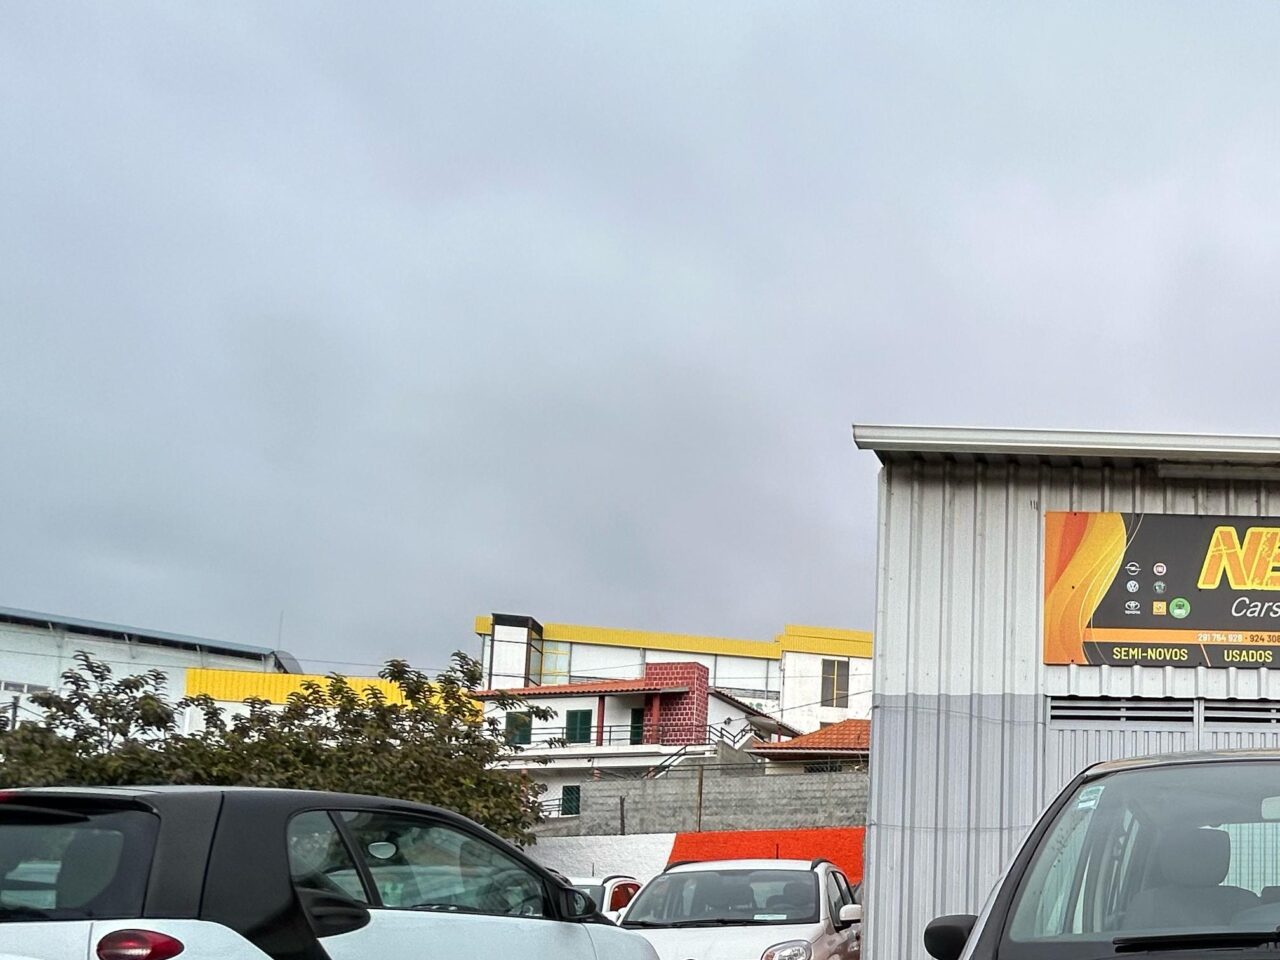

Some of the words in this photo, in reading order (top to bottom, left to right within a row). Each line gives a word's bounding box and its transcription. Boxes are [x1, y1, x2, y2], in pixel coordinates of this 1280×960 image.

[1249, 634, 1265, 643] 924
[1112, 647, 1189, 661] SEMI-NOVOS
[1223, 649, 1273, 662] USADOS
